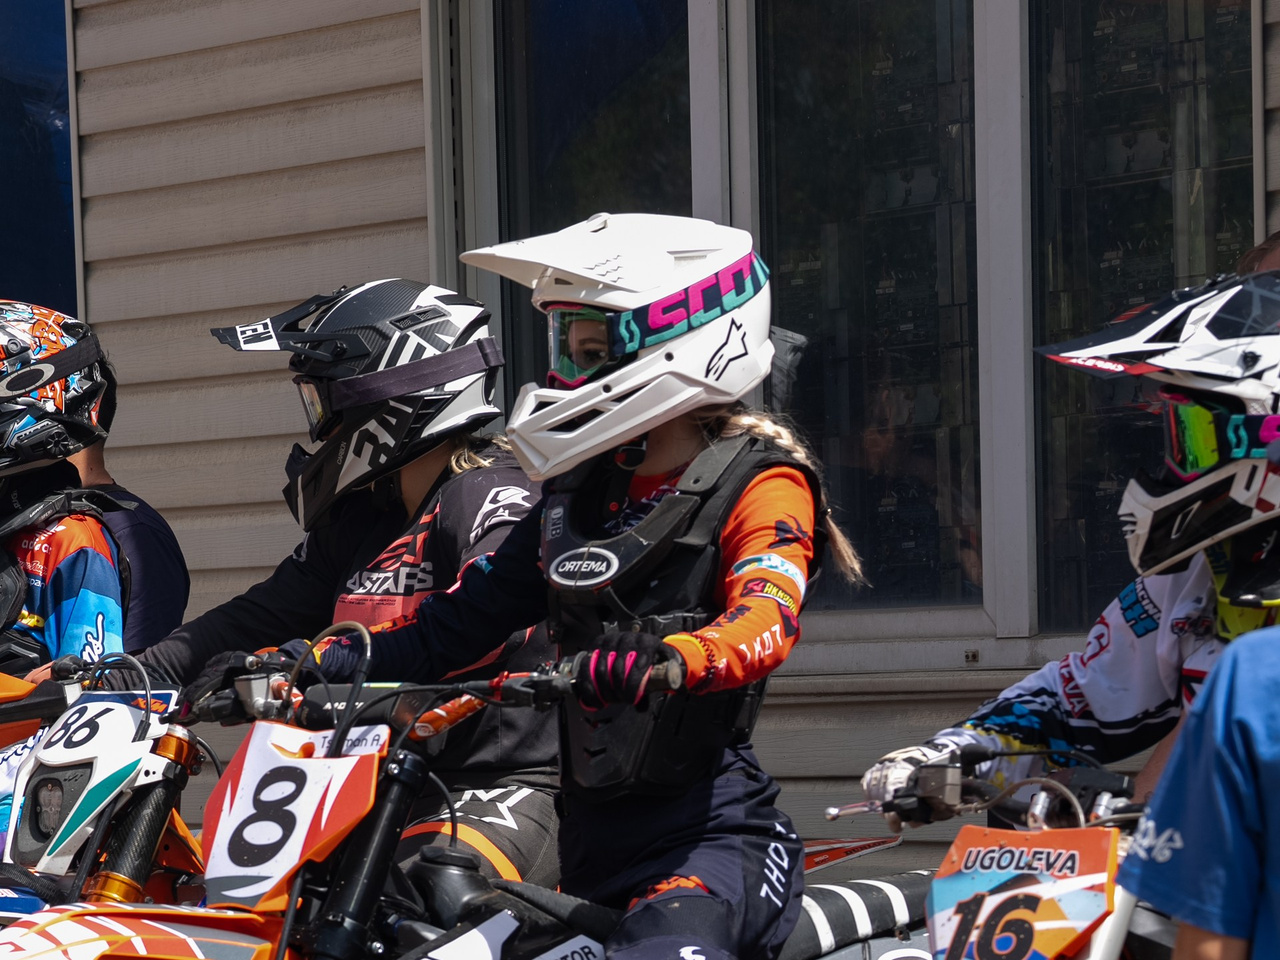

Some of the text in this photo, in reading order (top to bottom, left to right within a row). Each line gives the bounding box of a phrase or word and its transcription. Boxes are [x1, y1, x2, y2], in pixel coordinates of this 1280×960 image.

[557, 560, 608, 573] ORTEMA
[43, 705, 115, 750] 86
[227, 765, 308, 867] 8
[961, 849, 1080, 876] UGOLEVA
